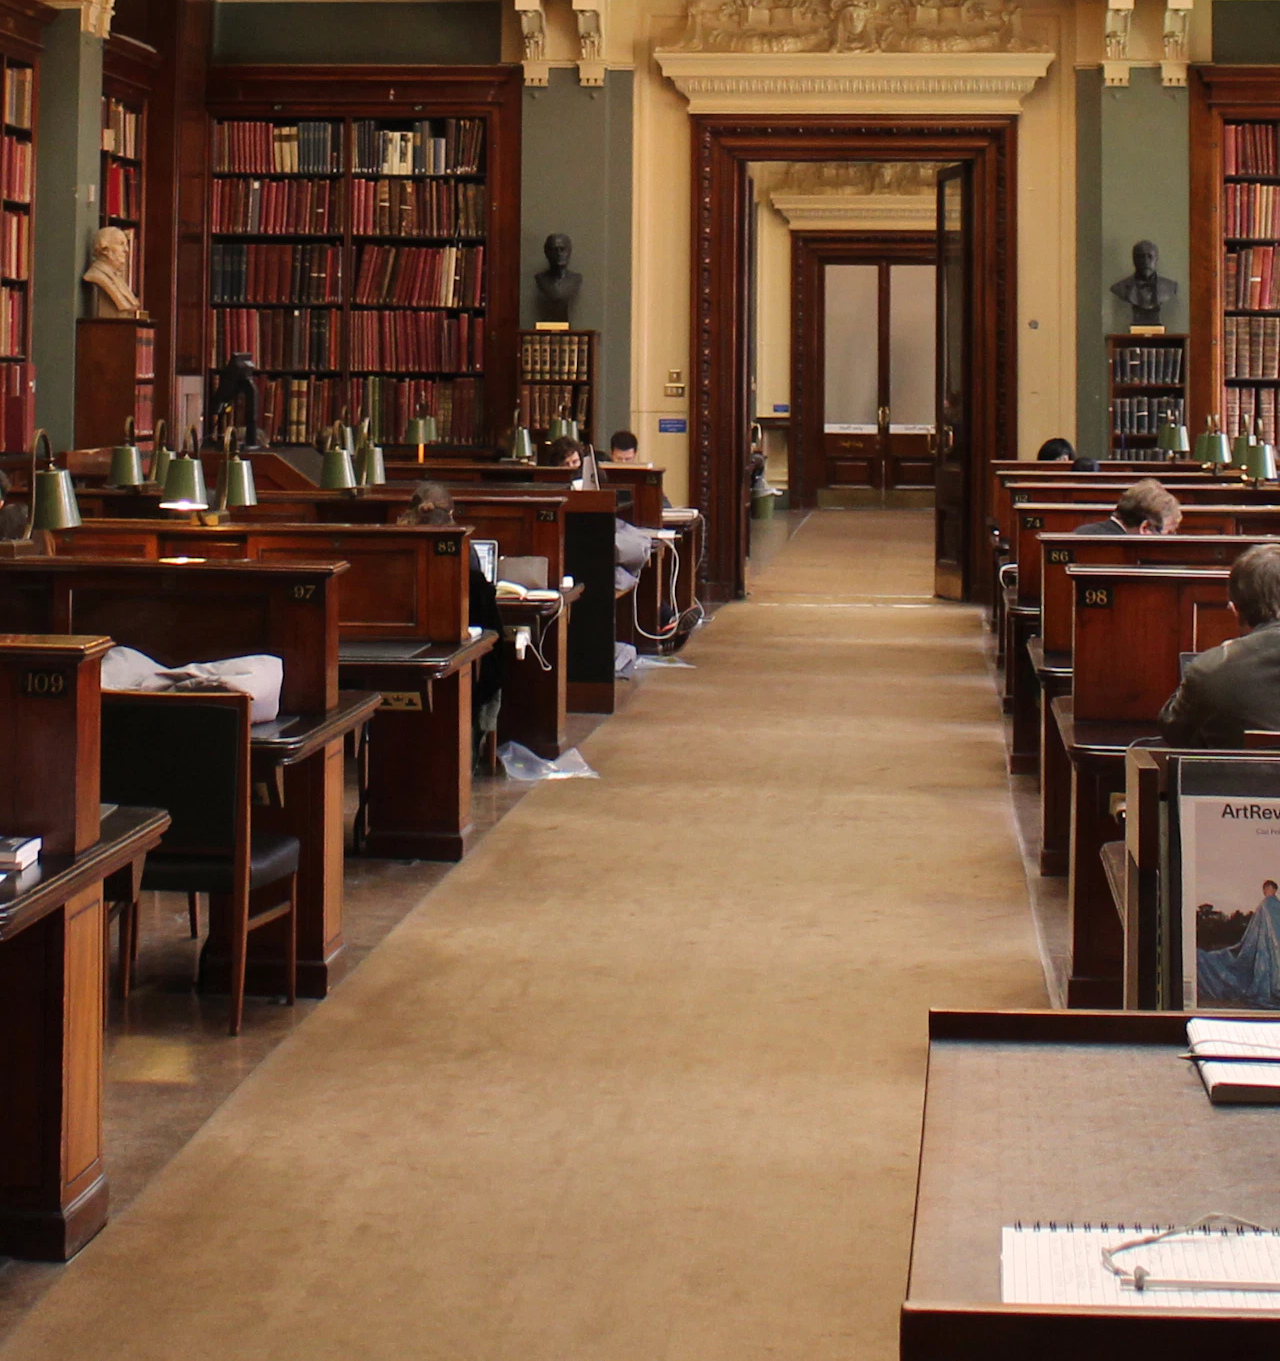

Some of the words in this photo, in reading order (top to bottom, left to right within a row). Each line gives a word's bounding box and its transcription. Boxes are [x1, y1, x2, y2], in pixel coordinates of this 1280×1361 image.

[539, 510, 554, 521] 73
[1026, 518, 1040, 528] 74
[436, 541, 456, 554] 85
[1051, 551, 1069, 562] 86
[293, 585, 316, 599] 97
[1085, 589, 1108, 604] 98
[27, 672, 64, 694] 109
